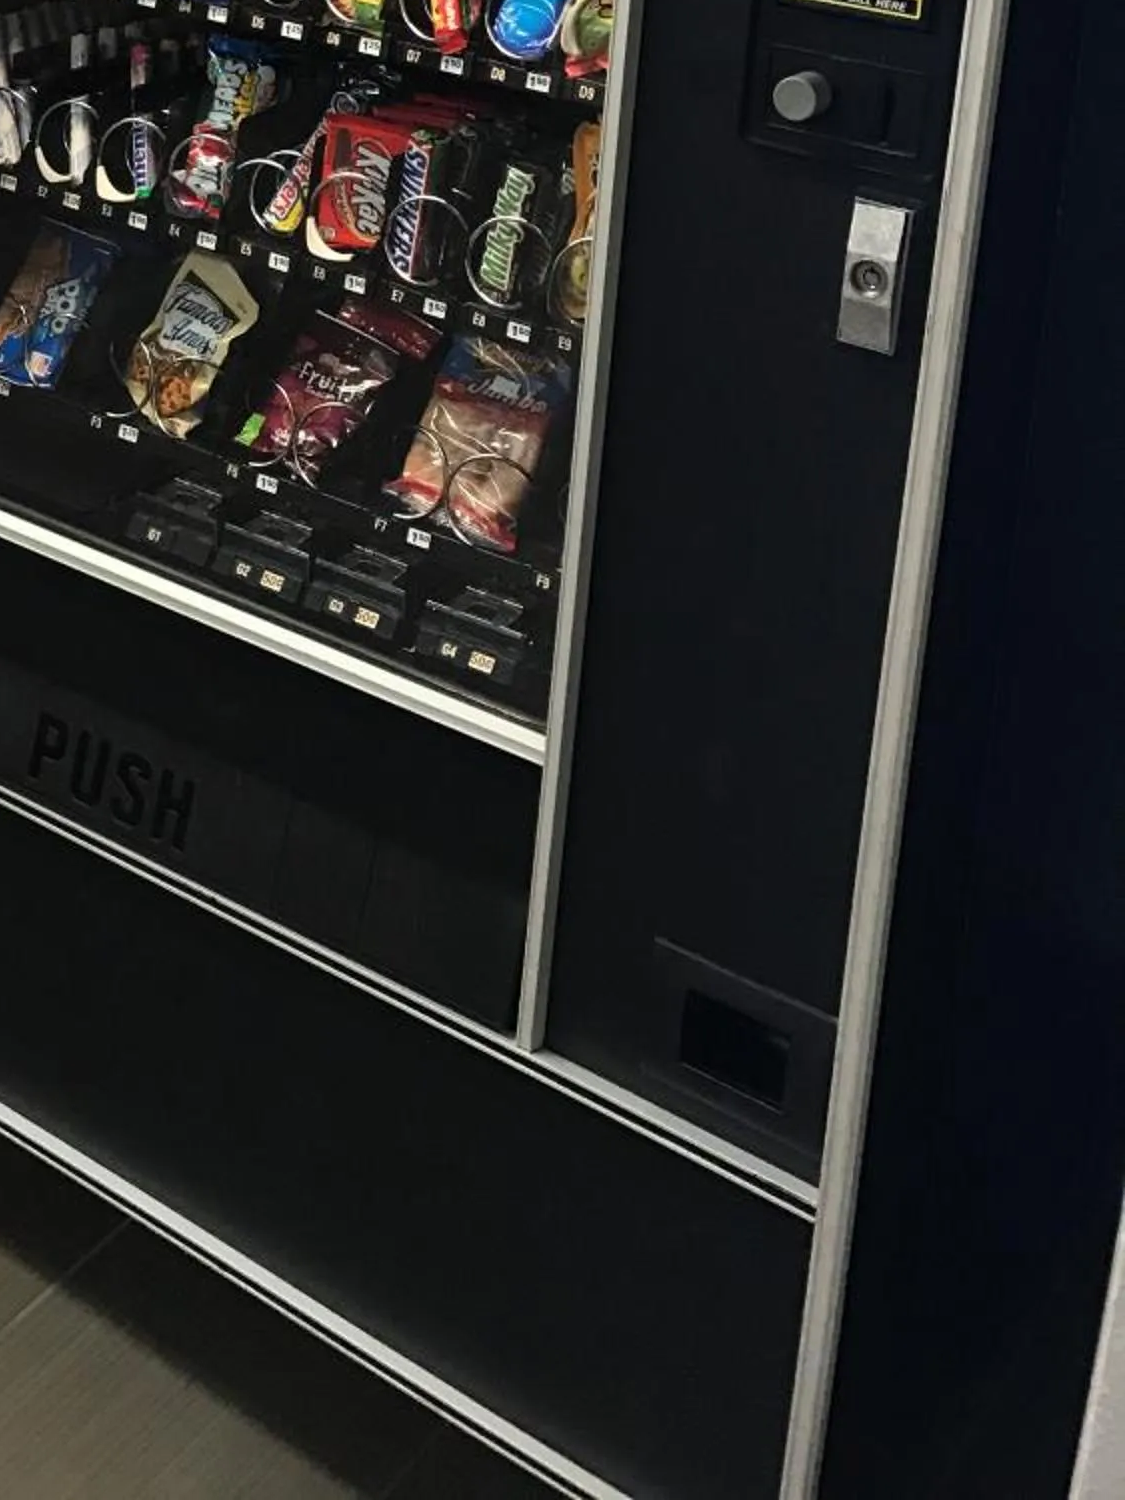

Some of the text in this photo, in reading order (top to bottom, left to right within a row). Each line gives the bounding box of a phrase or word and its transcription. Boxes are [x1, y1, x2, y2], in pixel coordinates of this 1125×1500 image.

[480, 164, 535, 291] Milky Way
[28, 711, 197, 851] PUSH
